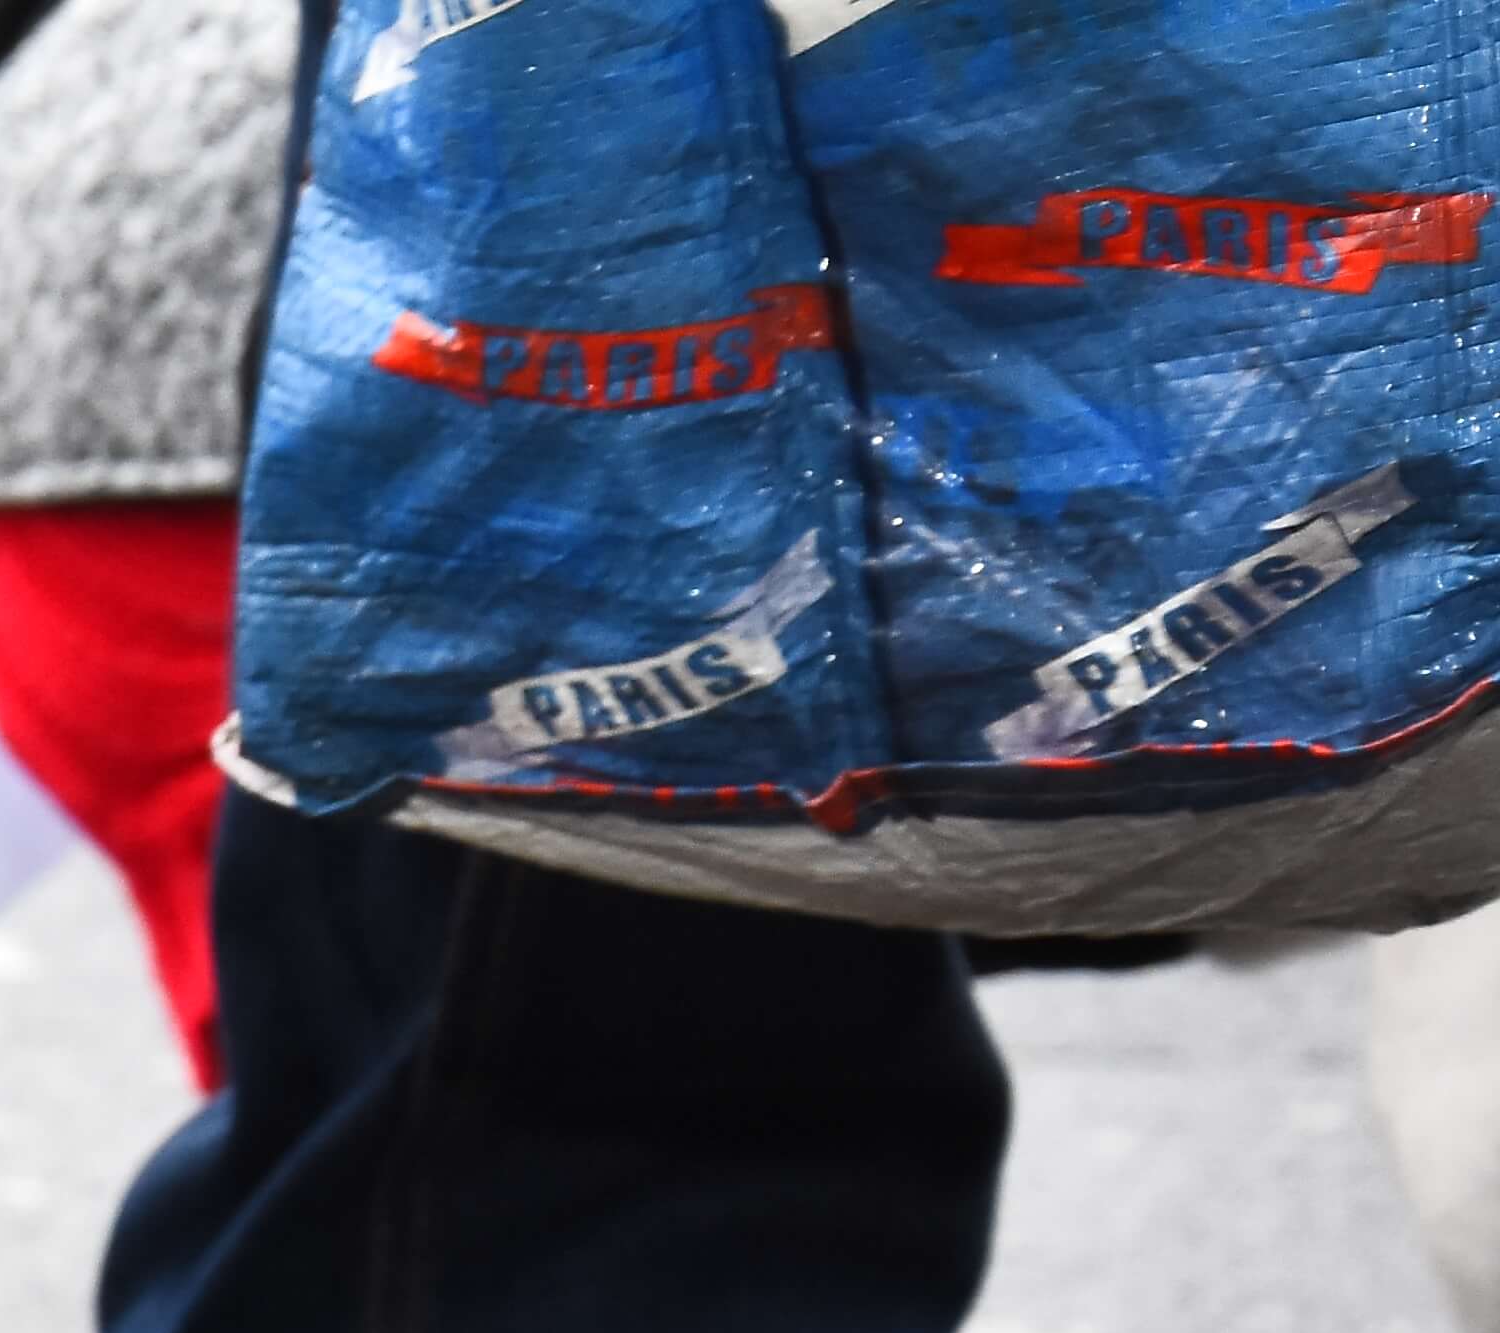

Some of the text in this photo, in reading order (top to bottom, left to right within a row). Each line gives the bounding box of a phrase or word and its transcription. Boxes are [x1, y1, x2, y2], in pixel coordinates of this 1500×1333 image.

[1079, 198, 1347, 284] PARIS
[482, 326, 755, 401] PARIS
[1067, 553, 1325, 716] PARIS
[522, 642, 753, 737] PARIS
